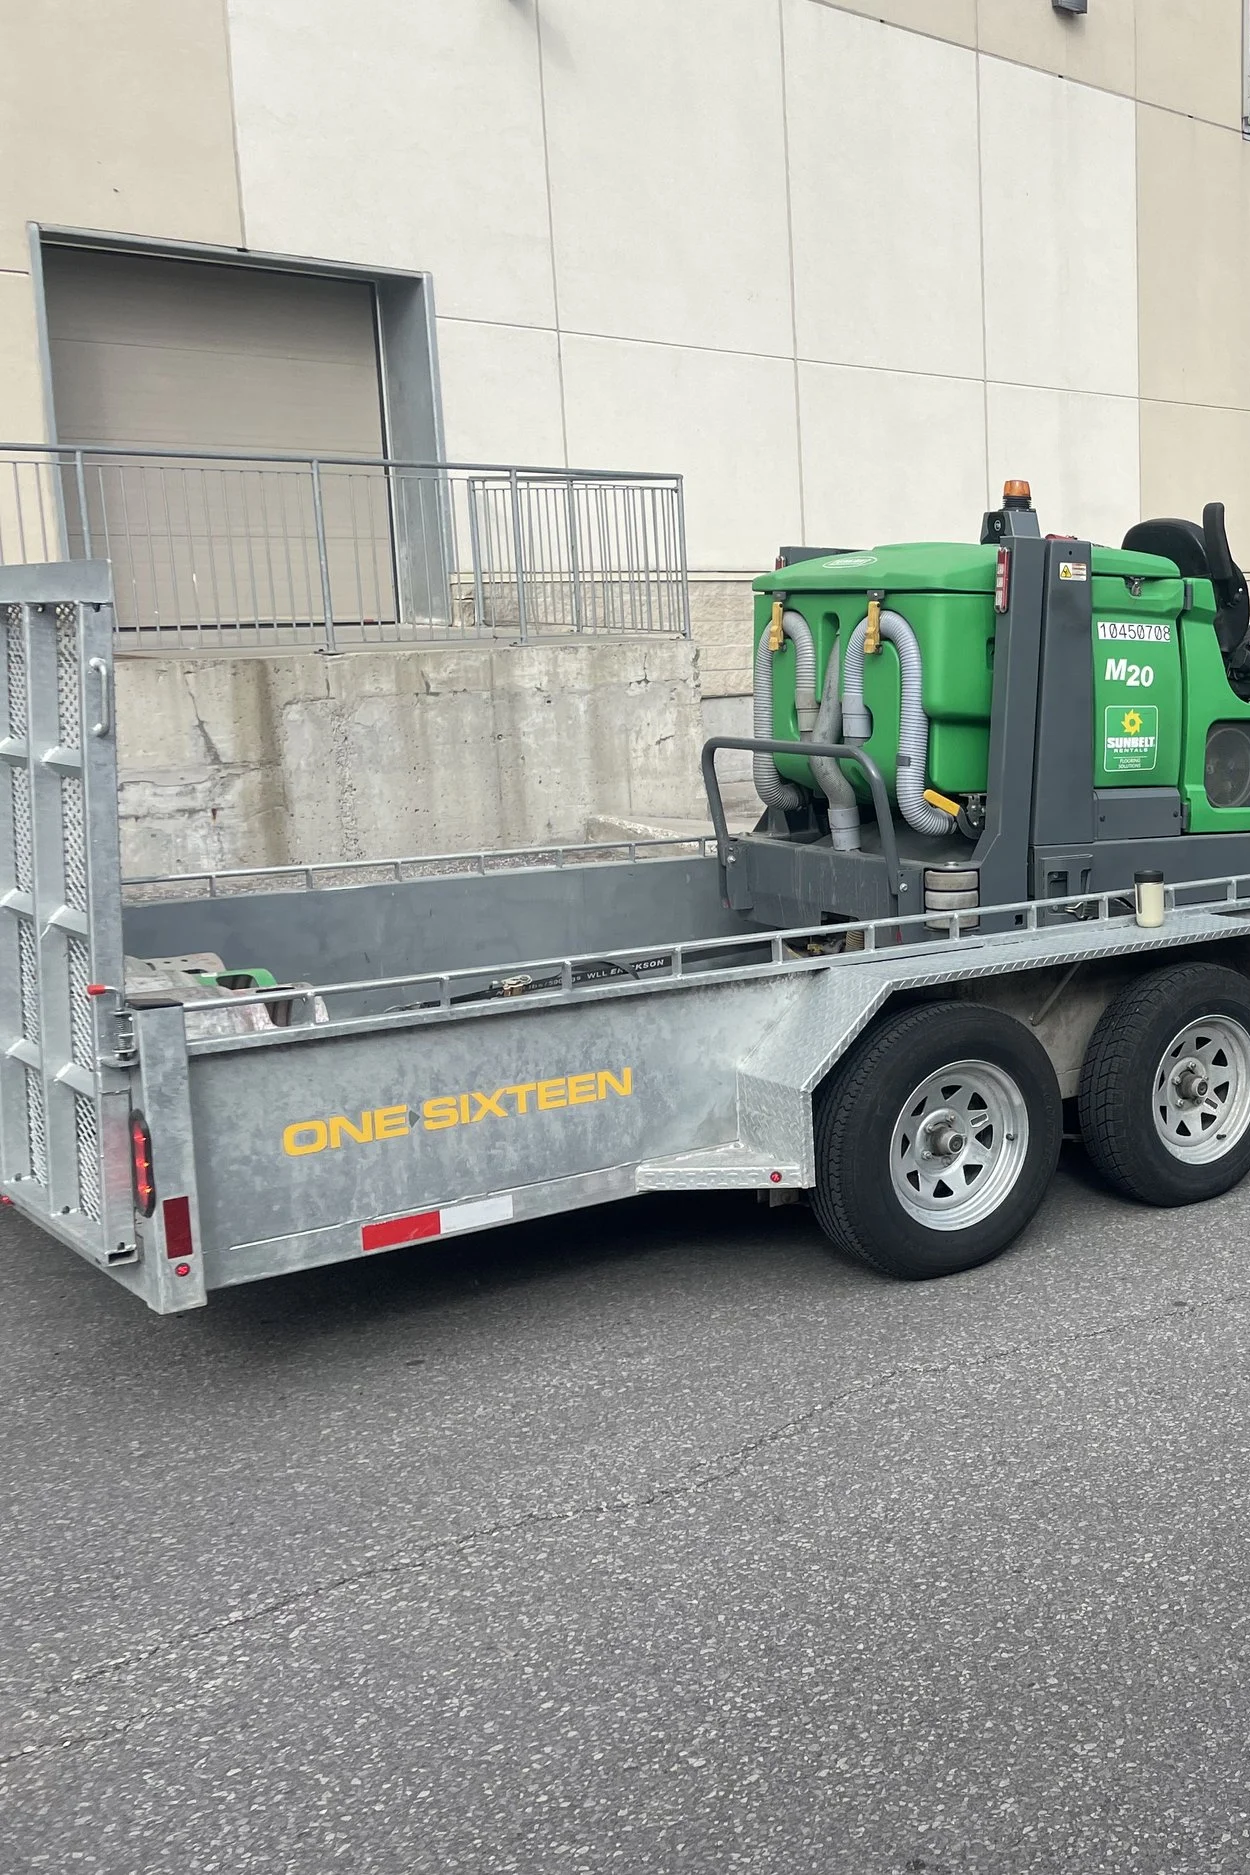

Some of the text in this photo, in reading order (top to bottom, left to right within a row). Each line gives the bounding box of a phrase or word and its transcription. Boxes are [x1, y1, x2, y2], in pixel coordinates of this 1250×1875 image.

[1100, 623, 1171, 641] 10450708
[1104, 658, 1154, 687] M20
[1107, 736, 1155, 749] SUNBELT
[587, 971, 608, 979] WLL
[610, 959, 665, 976] ERKSON
[282, 1067, 632, 1157] ONE SIXTEEN
